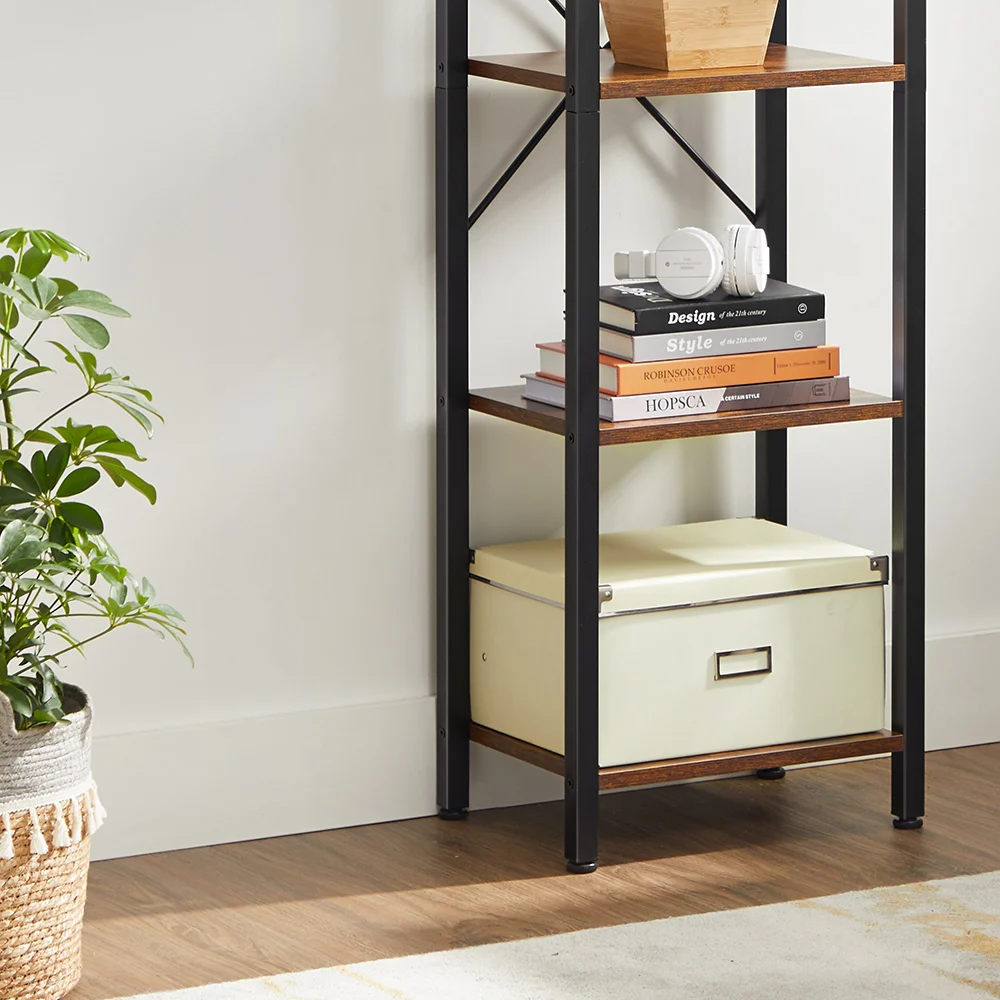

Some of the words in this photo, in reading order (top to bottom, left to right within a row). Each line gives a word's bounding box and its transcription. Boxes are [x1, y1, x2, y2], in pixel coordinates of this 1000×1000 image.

[667, 309, 716, 325] Design
[719, 311, 725, 319] of
[726, 310, 735, 318] the
[666, 335, 713, 355] Style
[719, 338, 726, 347] of
[748, 336, 767, 344] century
[643, 367, 696, 381] ROBINSON
[696, 364, 736, 376] CRUSOE
[645, 395, 706, 412] HOPSCA
[725, 394, 745, 402] CERTAIN
